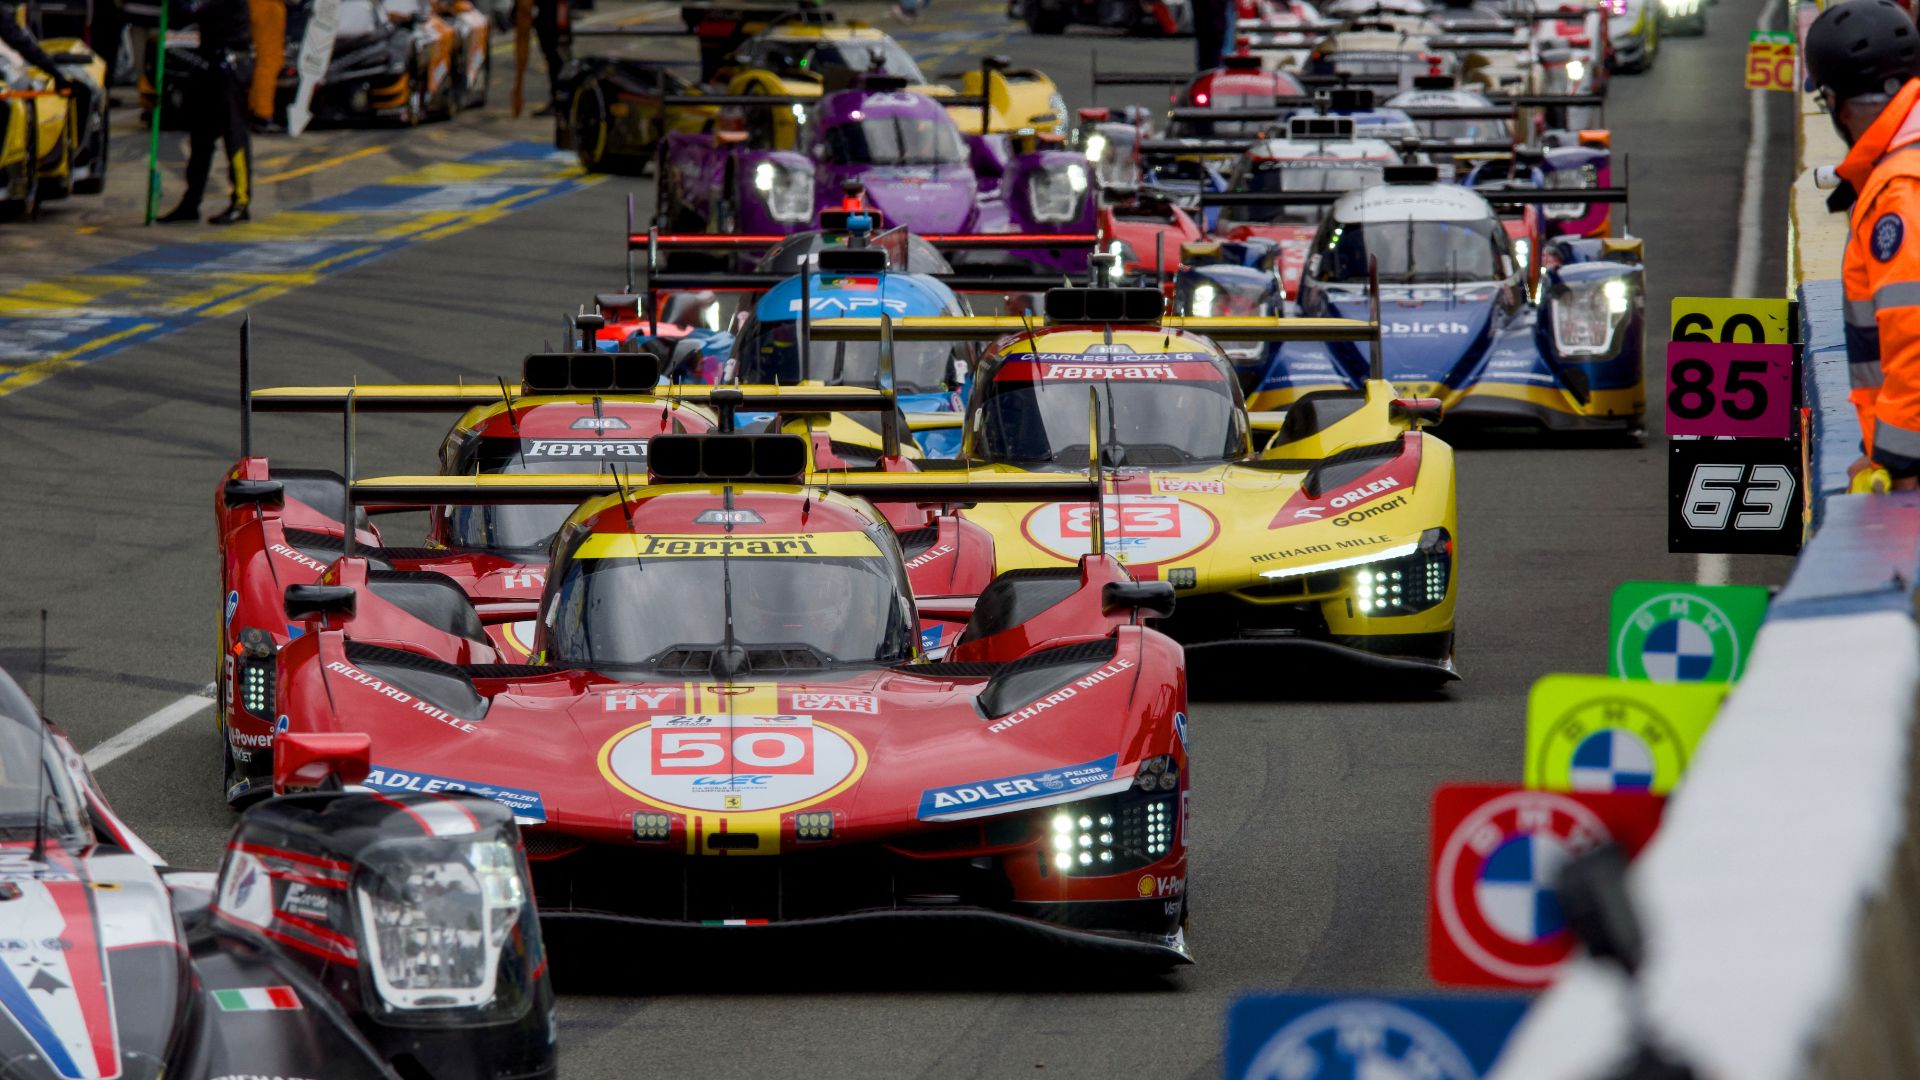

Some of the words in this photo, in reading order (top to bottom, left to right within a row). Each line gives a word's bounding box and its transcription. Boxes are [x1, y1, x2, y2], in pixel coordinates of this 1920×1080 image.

[1382, 322, 1469, 334] birth
[1020, 353, 1108, 362] CHARLES
[1112, 354, 1171, 362] POZZI
[1043, 364, 1178, 379] Ferrari
[1668, 358, 1768, 420] 85
[524, 440, 649, 456] Ferra
[1163, 485, 1218, 494] CAR
[1330, 476, 1399, 508] ORLEN
[1681, 464, 1796, 530] 63
[1067, 507, 1174, 532] 83
[1332, 495, 1407, 526] GOmart
[638, 535, 817, 555] Ferrari
[1250, 544, 1332, 563] RICHARD
[1336, 534, 1392, 549] MILLE
[270, 544, 328, 573] RICHAR
[905, 545, 954, 569] MILLE
[325, 661, 412, 703] RICHARD
[412, 700, 478, 733] MILLE
[606, 694, 670, 711] HY
[798, 700, 872, 712] CAR
[987, 687, 1078, 733] RICHARD
[1079, 659, 1135, 690] MILLE
[660, 732, 805, 767] 50
[692, 774, 774, 785] WEC
[1063, 767, 1103, 779] PELZER
[1069, 773, 1109, 785] GROUP
[497, 791, 538, 803] PELZER
[934, 778, 1040, 808] ADLER
